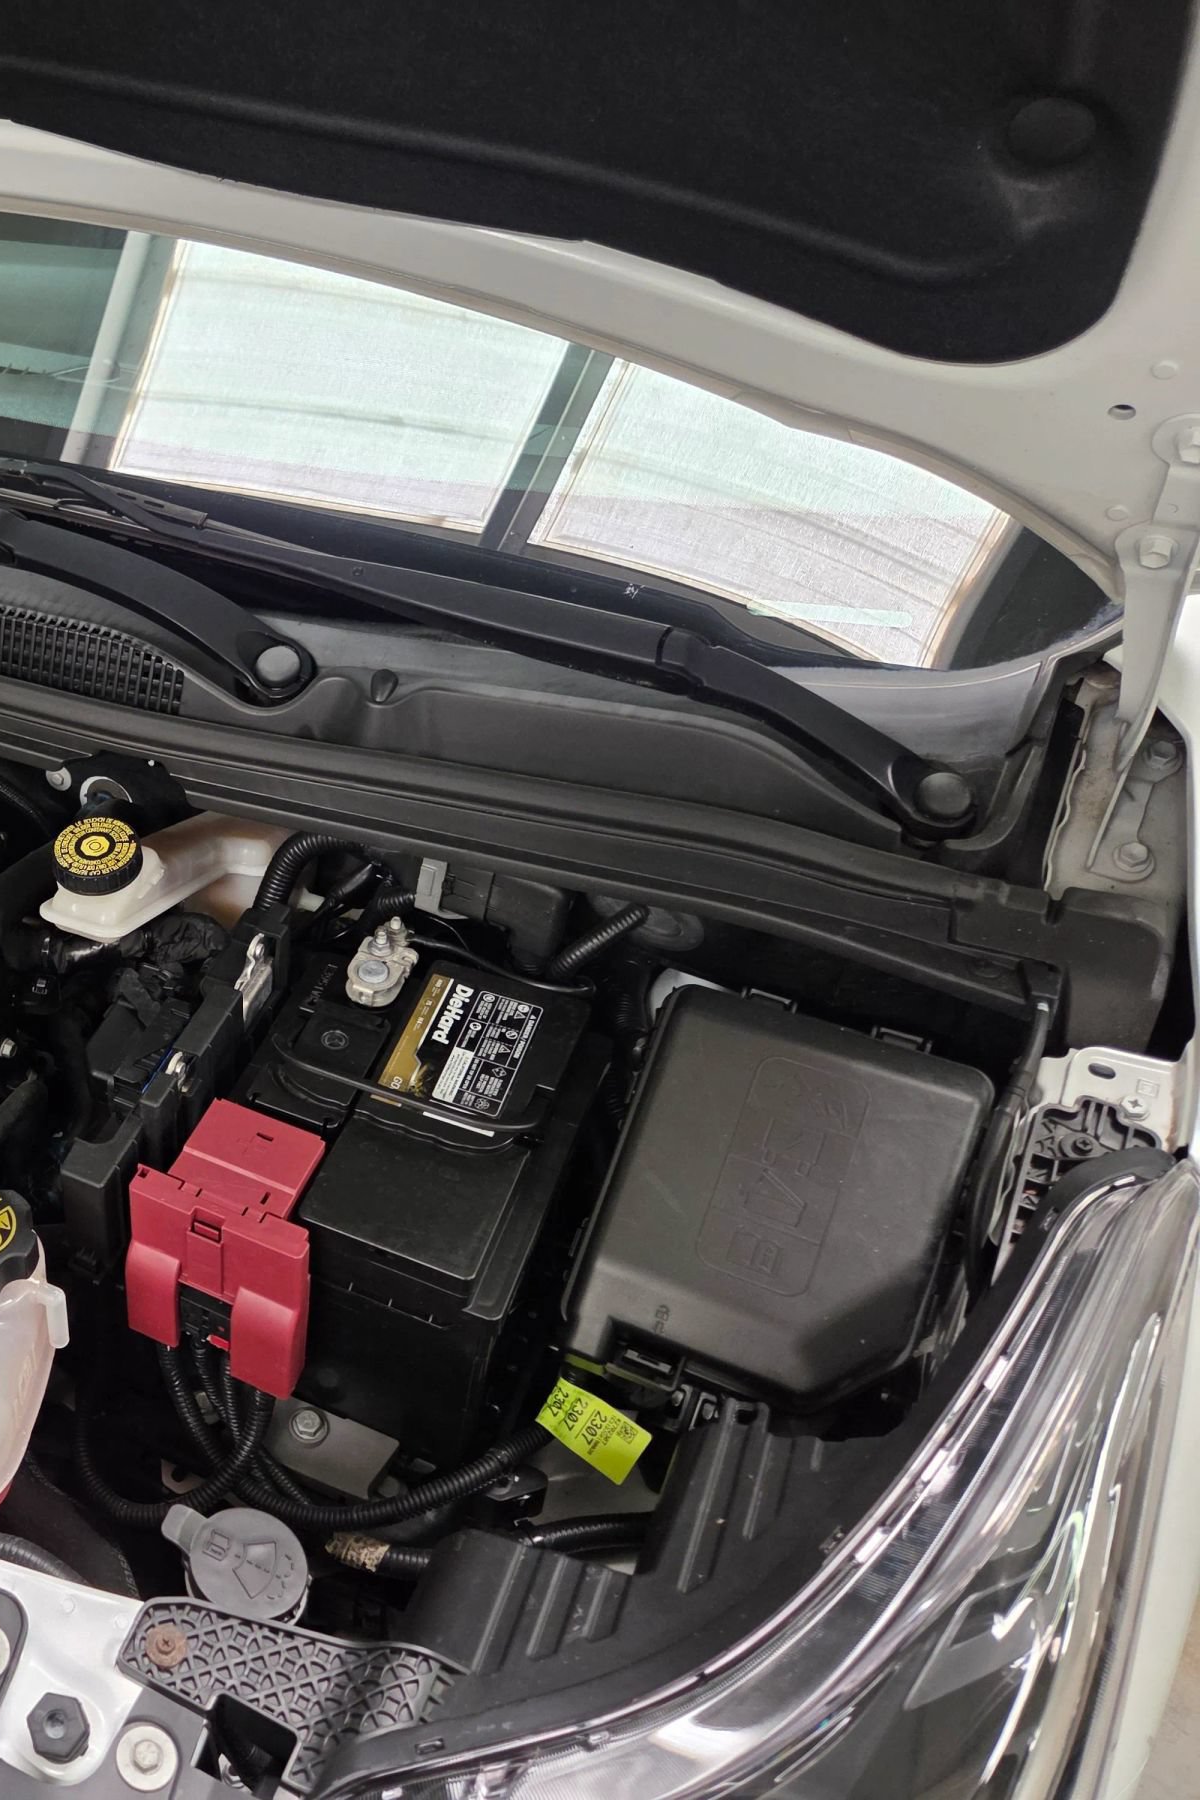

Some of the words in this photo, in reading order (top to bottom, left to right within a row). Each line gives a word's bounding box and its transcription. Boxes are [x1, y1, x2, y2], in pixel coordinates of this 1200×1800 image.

[432, 983, 475, 1045] DieHard
[548, 1387, 569, 1417] 2307
[563, 1397, 588, 1431] 2307
[582, 1410, 607, 1446] 2307
